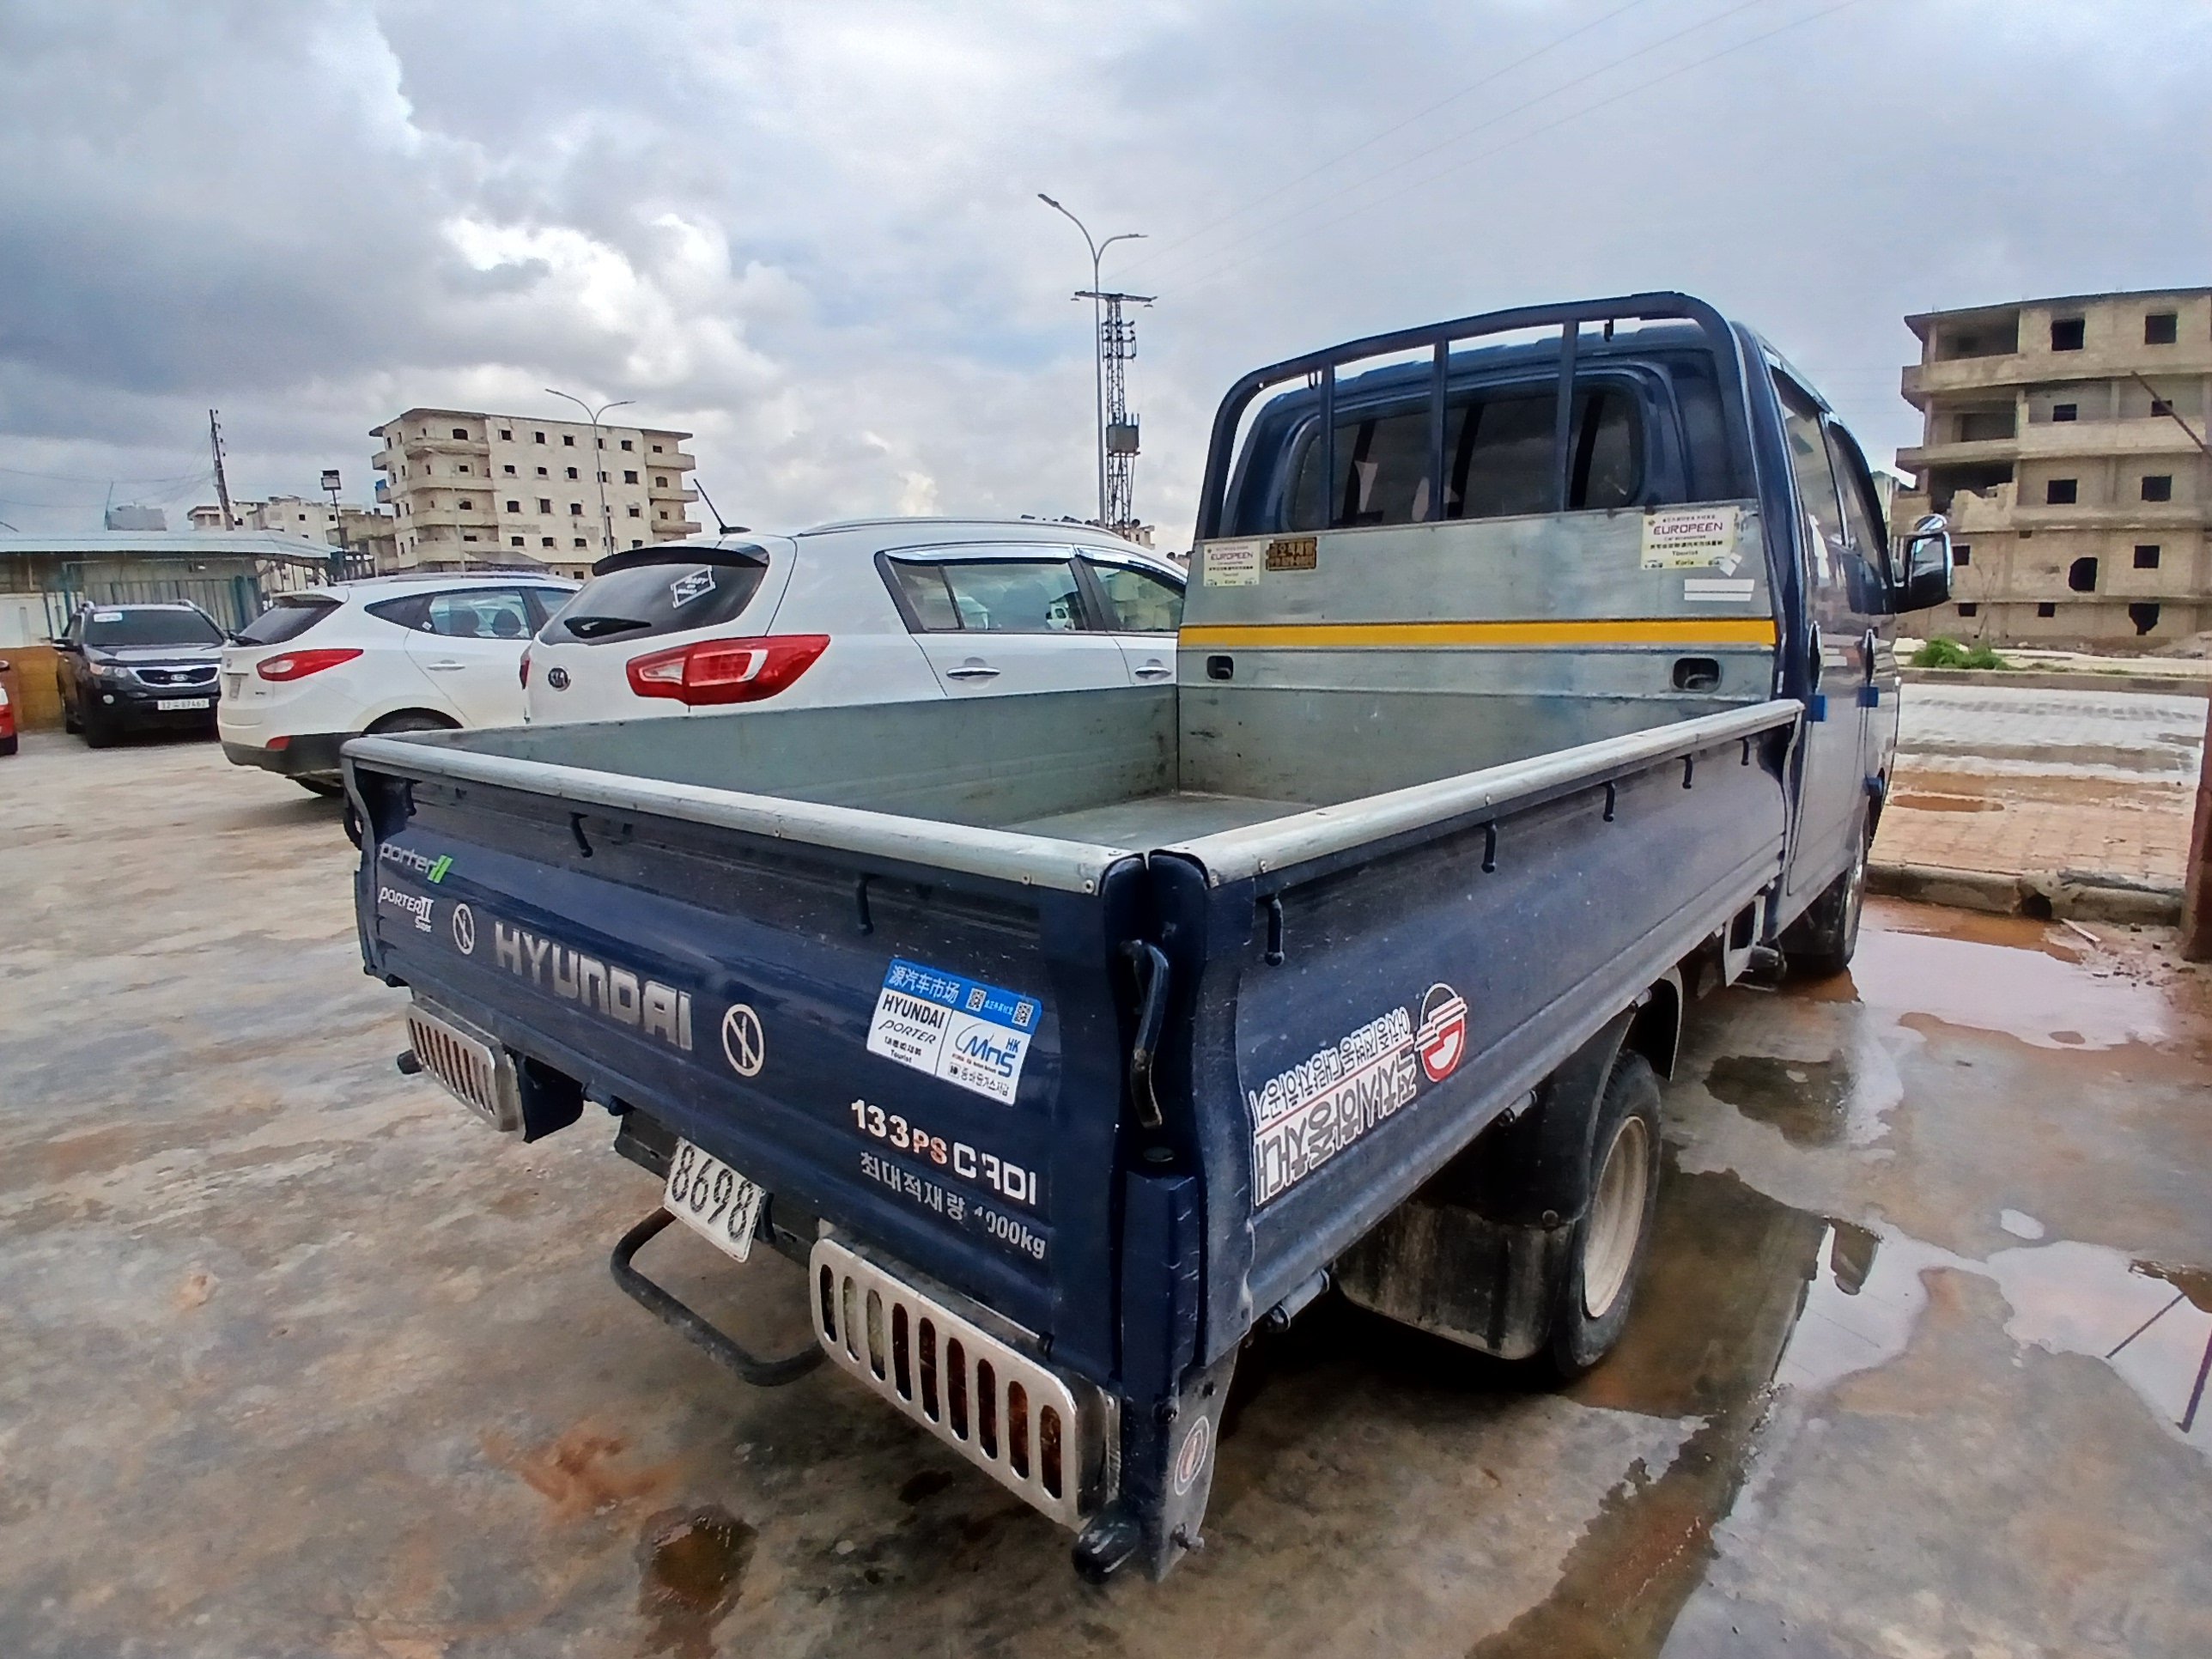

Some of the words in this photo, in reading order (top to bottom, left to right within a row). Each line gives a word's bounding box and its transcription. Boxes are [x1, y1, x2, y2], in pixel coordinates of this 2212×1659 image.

[1653, 522, 1723, 536] EUROPEEN
[495, 921, 693, 1051] HYUNDAI
[882, 994, 946, 1030] HYUNDAI
[851, 1099, 948, 1165] 133PS
[672, 1145, 754, 1242] 8698
[860, 1152, 966, 1221] 최대적재량
